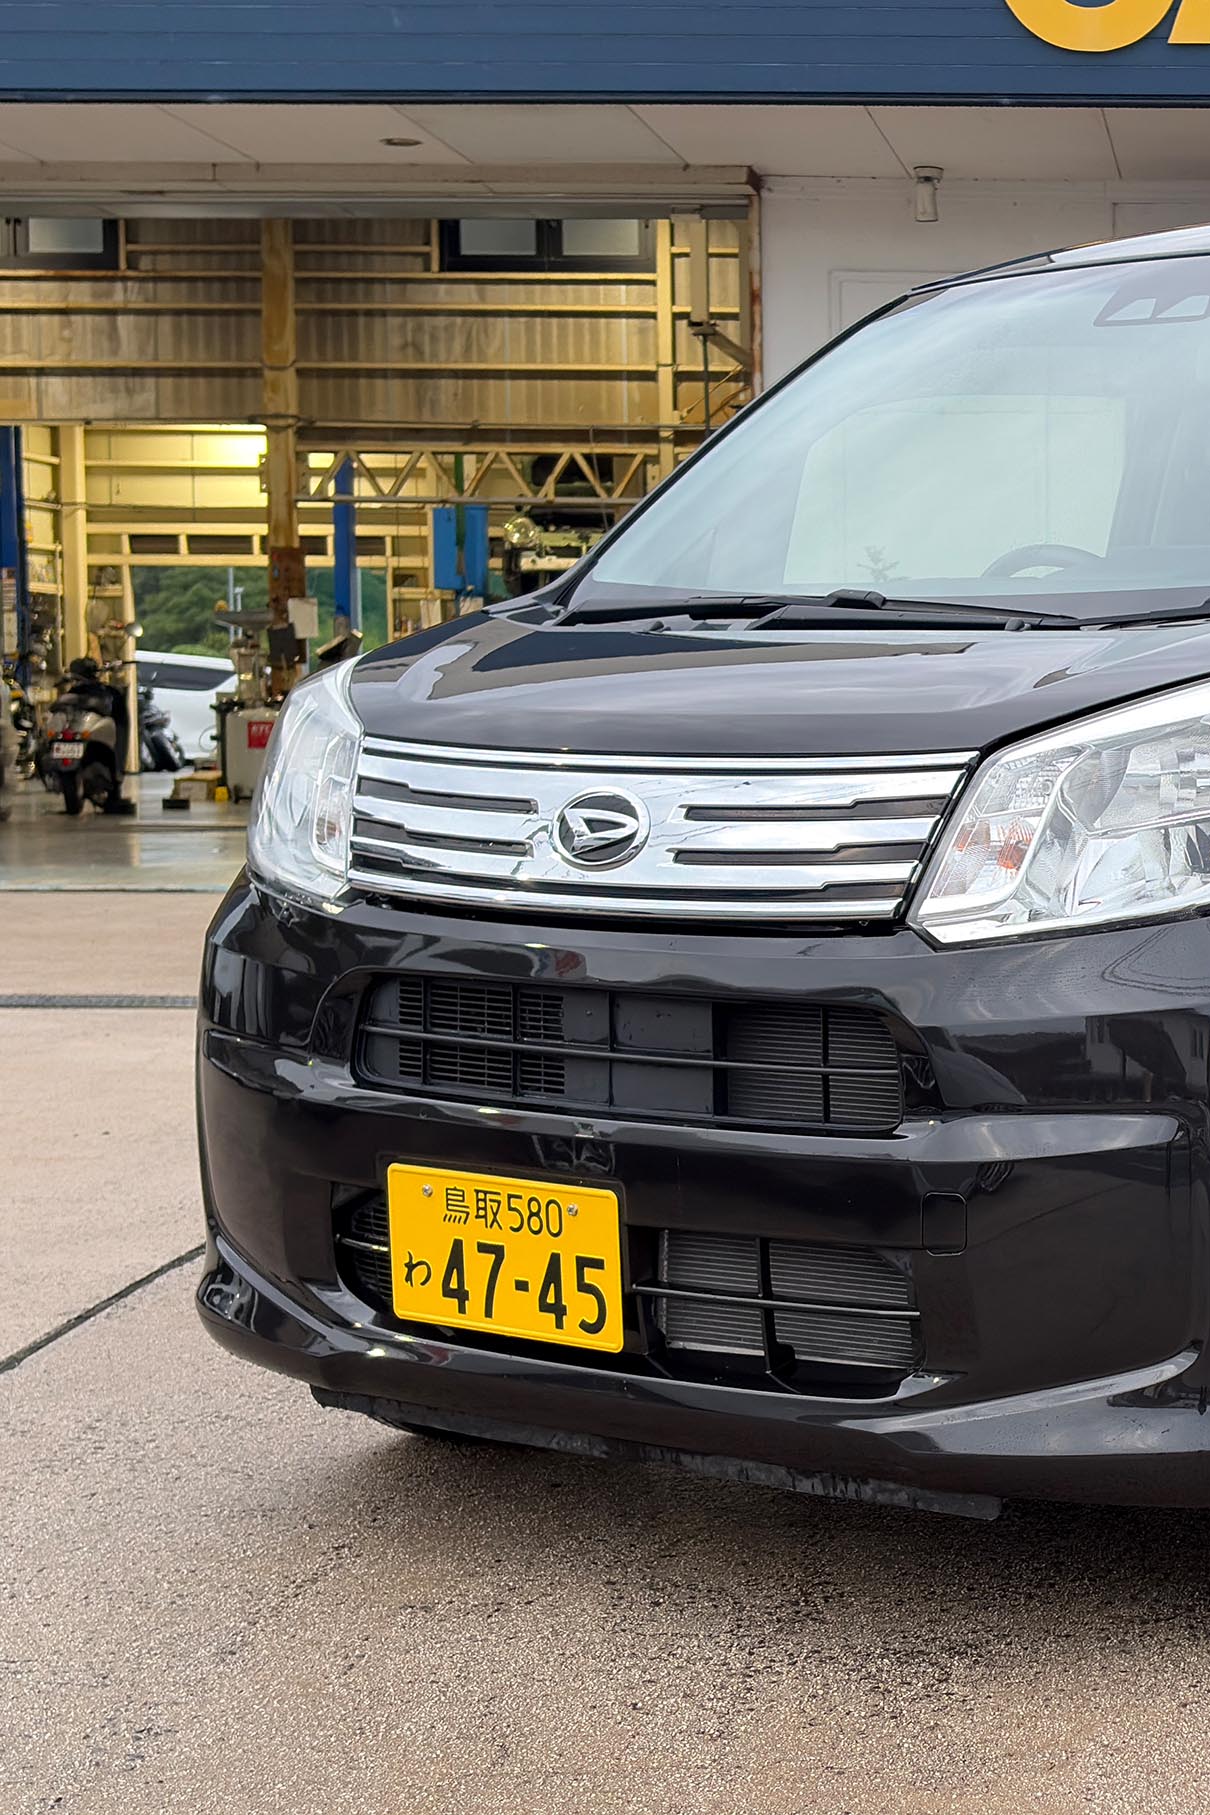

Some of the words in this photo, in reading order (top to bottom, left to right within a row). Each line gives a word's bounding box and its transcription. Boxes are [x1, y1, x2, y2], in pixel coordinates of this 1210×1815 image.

[442, 1186, 563, 1238] 鳥取580
[404, 1250, 432, 1288] わ
[441, 1236, 608, 1335] 47-45
